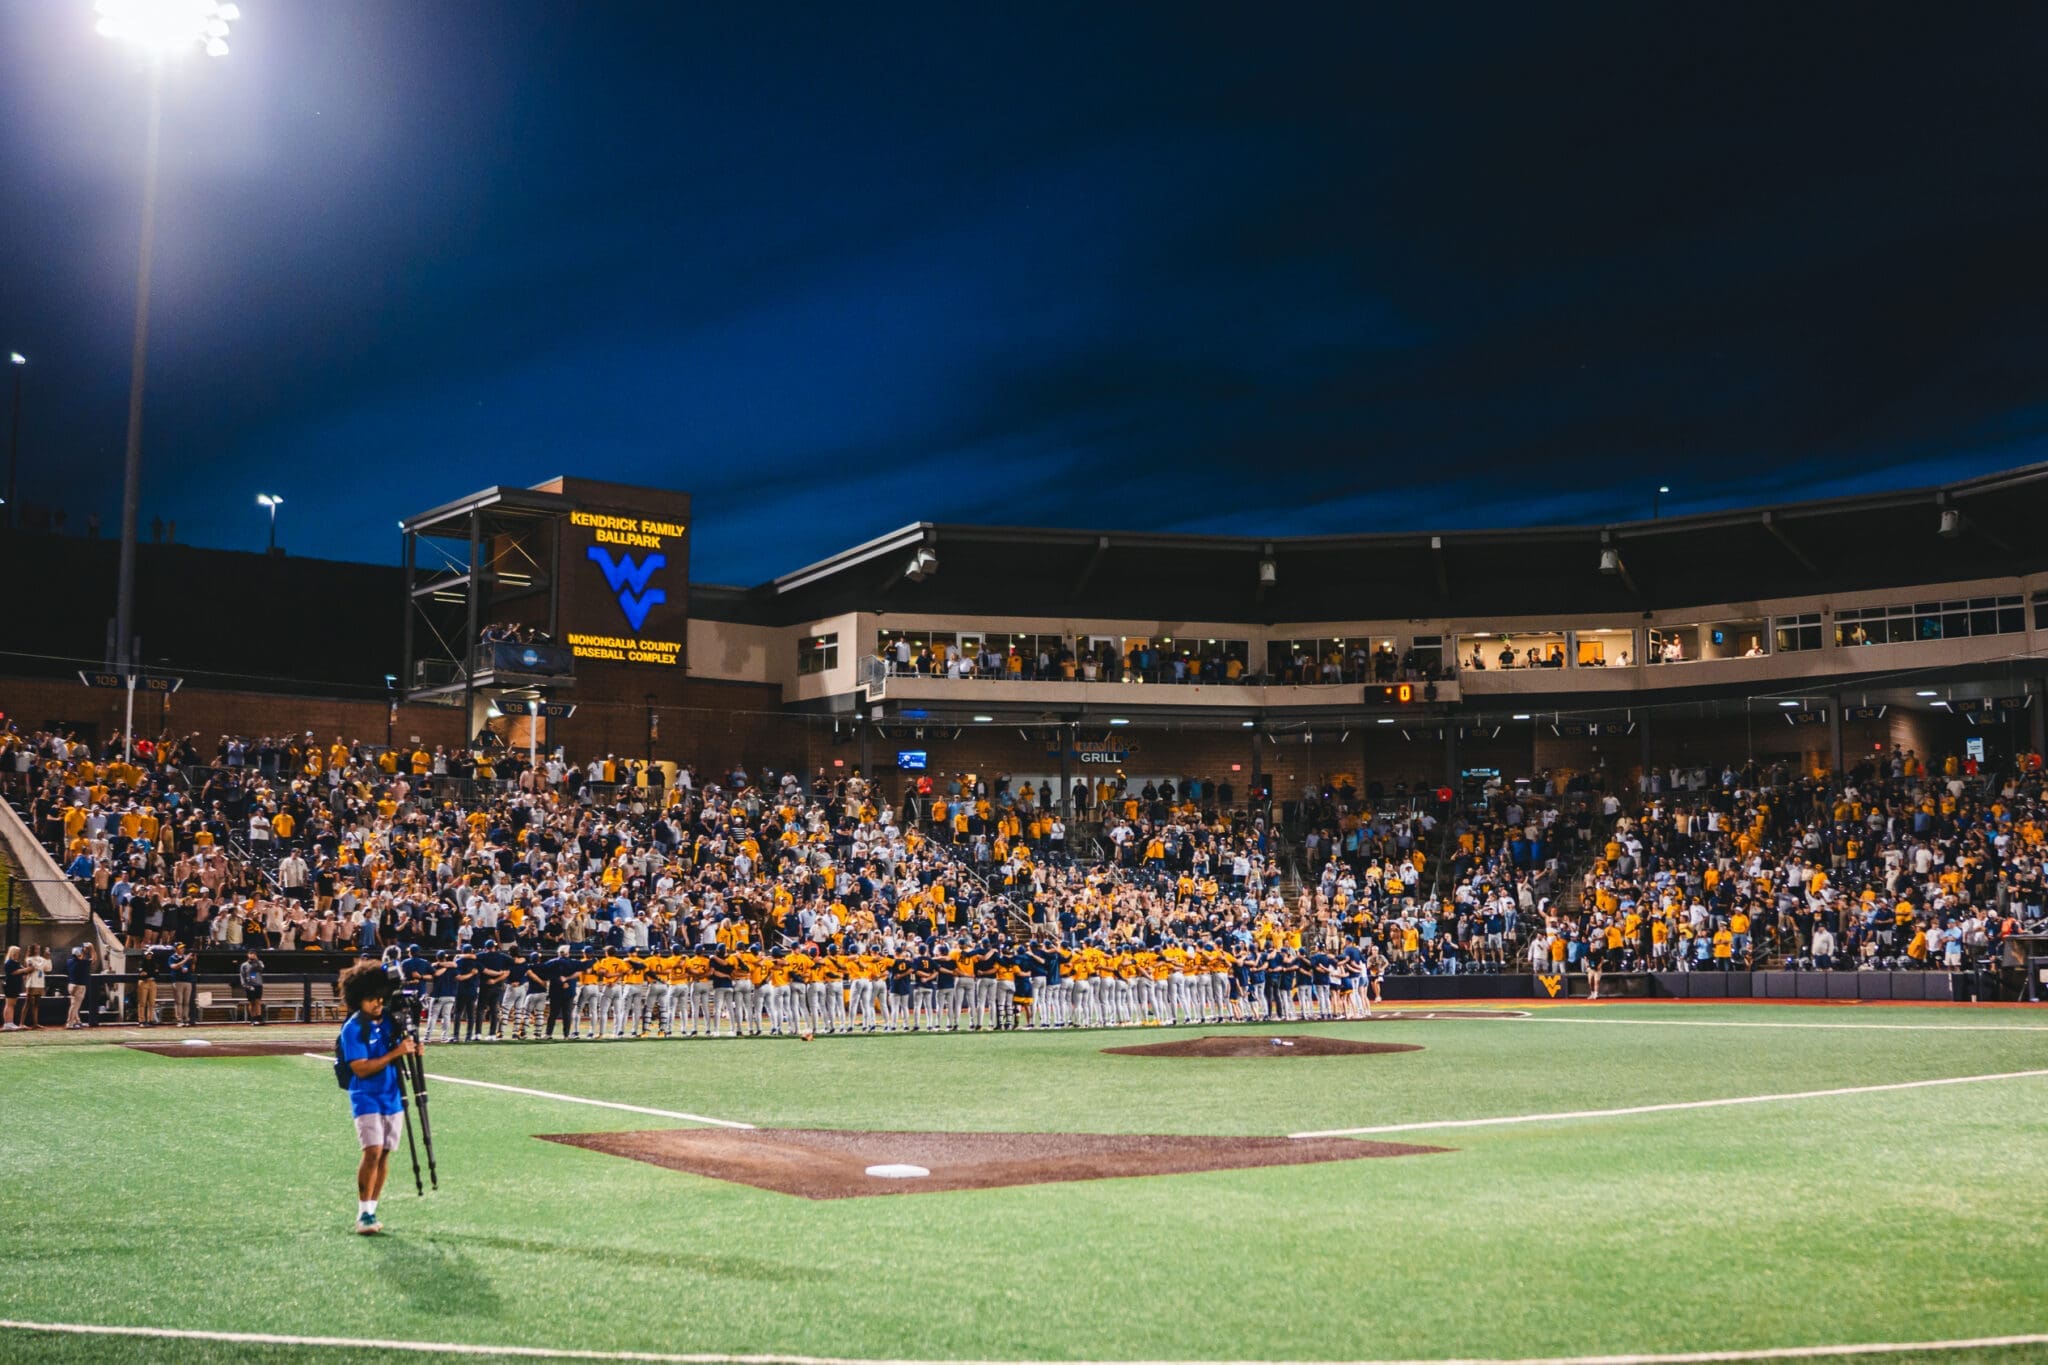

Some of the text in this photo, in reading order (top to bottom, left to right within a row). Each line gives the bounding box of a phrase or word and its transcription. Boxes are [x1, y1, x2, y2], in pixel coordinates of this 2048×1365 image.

[570, 511, 685, 537] KENDRICK FAMILY
[596, 529, 661, 548] BALLPARK
[567, 634, 681, 653] MONONGALIA COUNTY
[573, 646, 676, 664] BASEBALL COMPLEX
[96, 676, 118, 686] 109
[505, 703, 523, 713] 108
[546, 706, 563, 716] 107
[1080, 752, 1122, 763] GRILL
